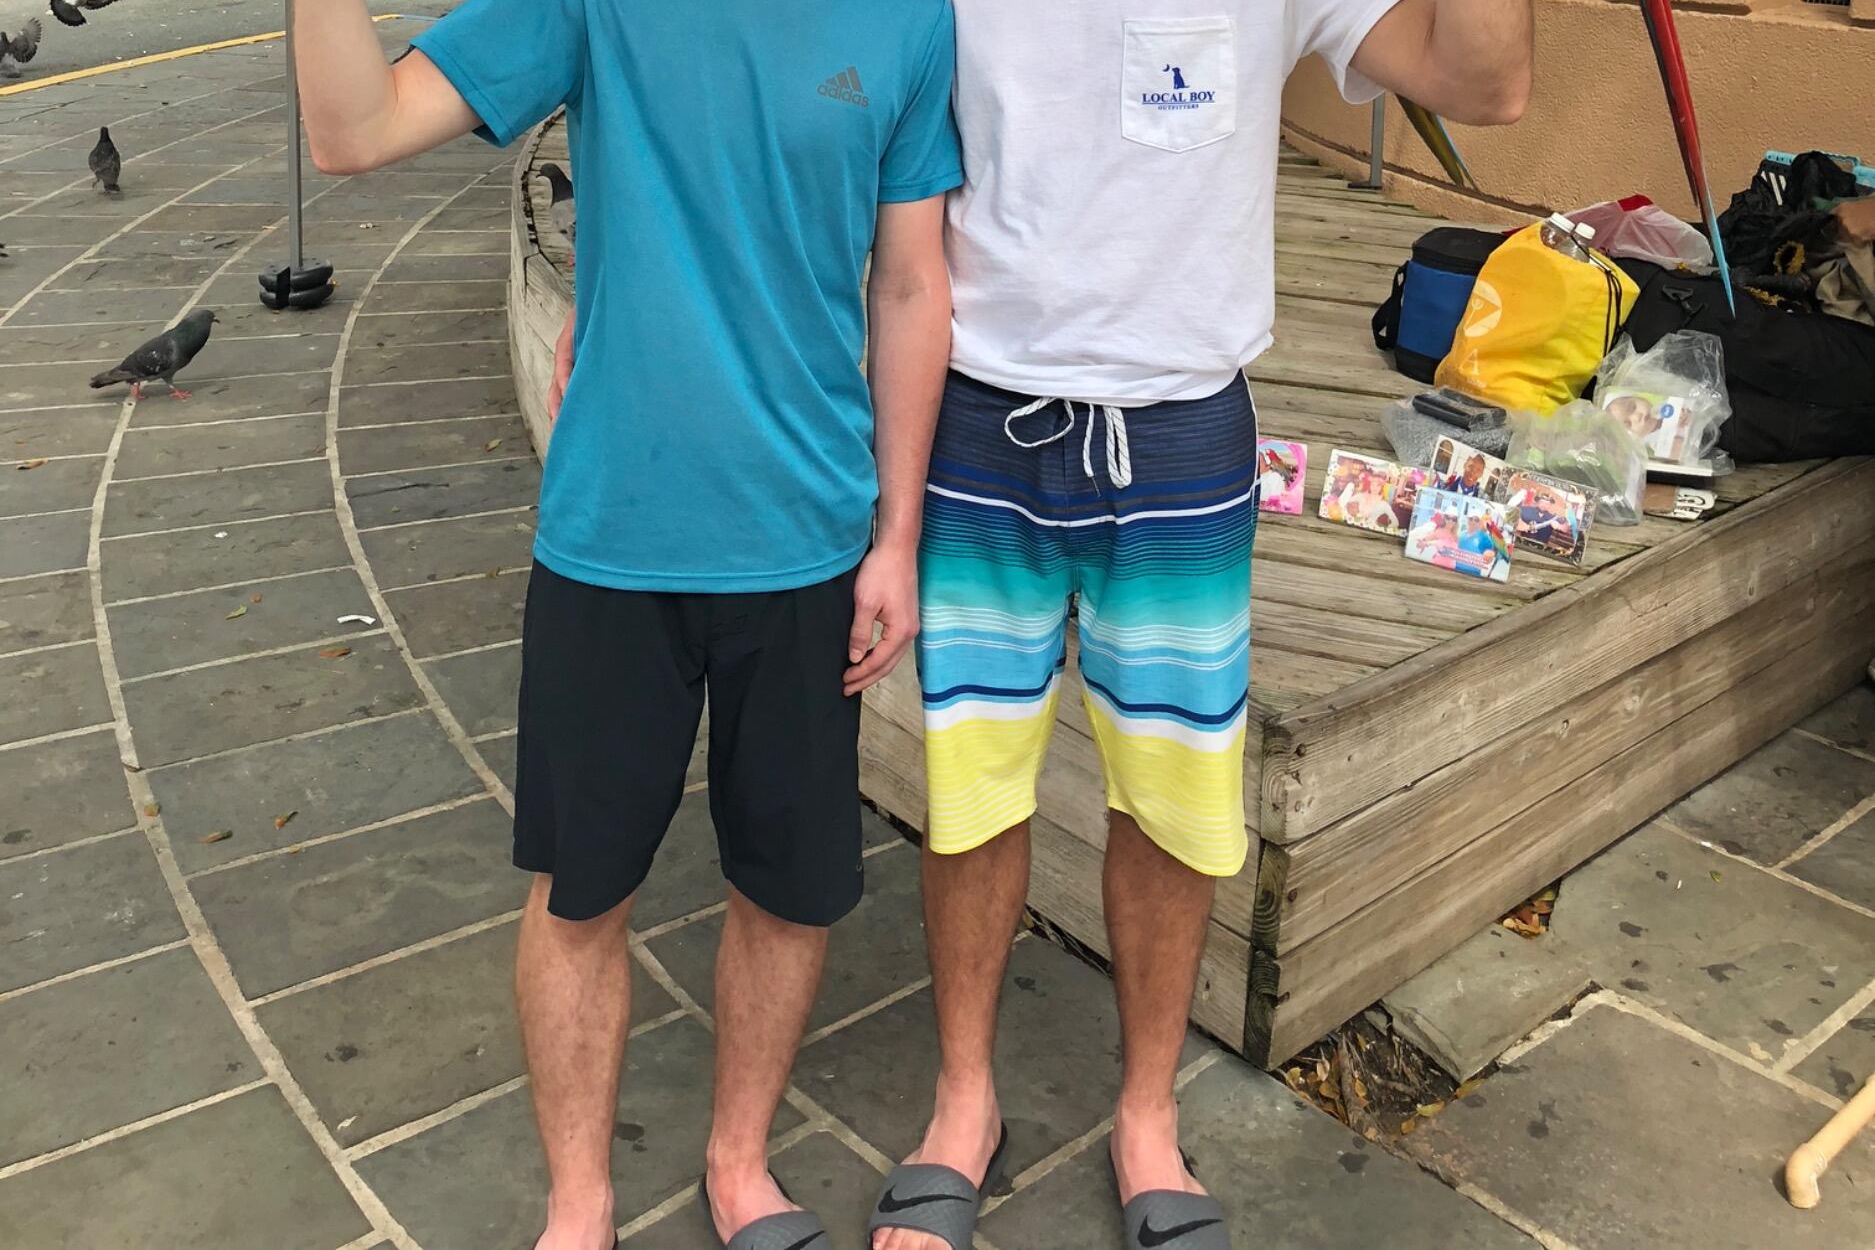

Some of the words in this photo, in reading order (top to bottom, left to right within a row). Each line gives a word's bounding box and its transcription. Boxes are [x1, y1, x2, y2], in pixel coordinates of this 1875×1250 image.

[817, 83, 869, 107] adidas
[1142, 92, 1187, 103] LOCAL
[1189, 91, 1216, 101] BOY
